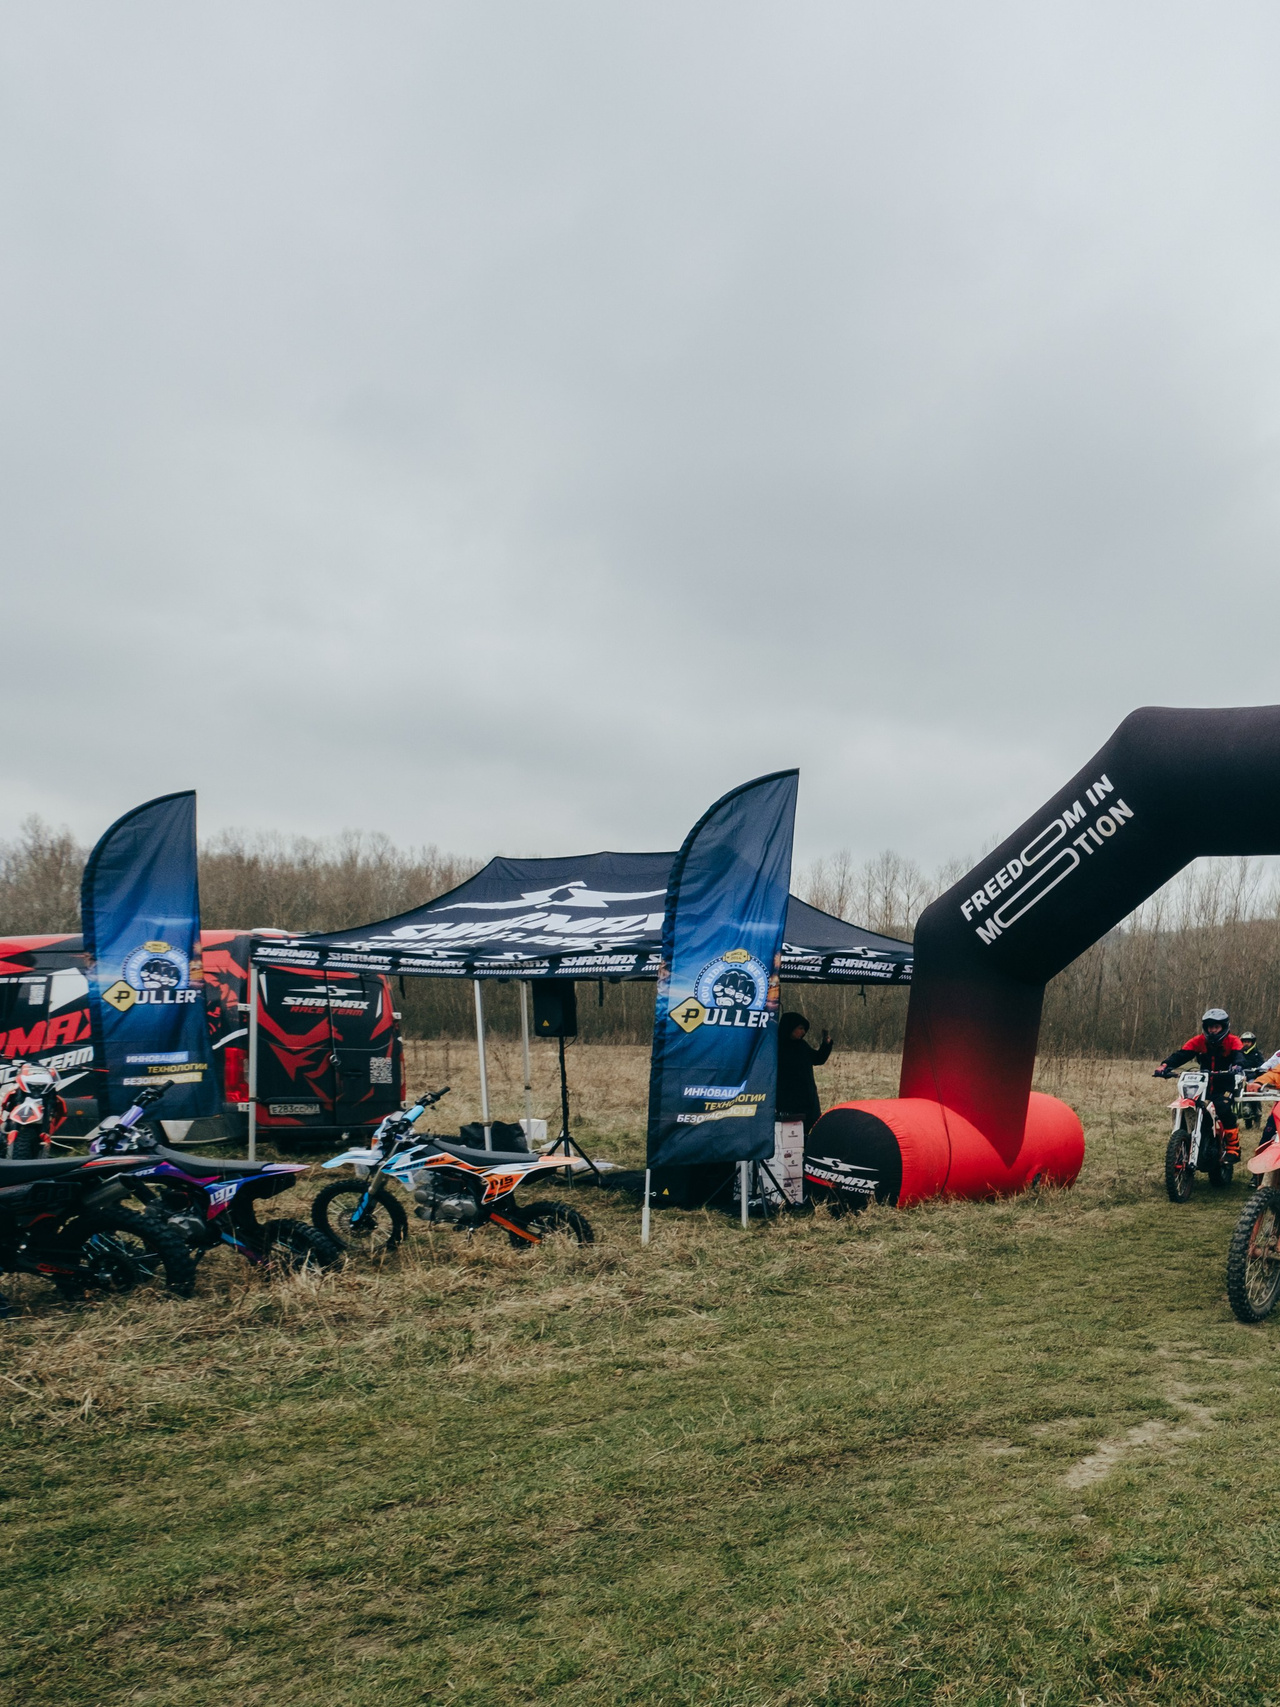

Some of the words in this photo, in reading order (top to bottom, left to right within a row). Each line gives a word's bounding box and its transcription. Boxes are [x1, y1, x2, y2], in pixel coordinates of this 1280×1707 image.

[960, 800, 1087, 922] FREEDOM
[1085, 774, 1115, 807] IN
[975, 798, 1135, 945] MOTION
[255, 947, 321, 960] SHARMAX
[327, 952, 393, 964] SHARMAX
[559, 954, 638, 967] SHARMAX
[830, 957, 897, 972] SHARMAX
[705, 963, 726, 985] RIDE
[746, 963, 760, 977] WE
[797, 964, 821, 972] RACE
[871, 971, 892, 979] RACE
[113, 989, 197, 1004] PULLER
[701, 985, 712, 1006] YOU
[281, 997, 370, 1010] SHARMAX
[290, 1006, 325, 1014] RACE
[331, 1008, 364, 1016] TEAM
[147, 1063, 208, 1074] ТЕХНОЛОГИИ
[804, 1163, 879, 1189] SHARMAX
[210, 1183, 238, 1206] 190
[841, 1185, 875, 1195] MOTORS
